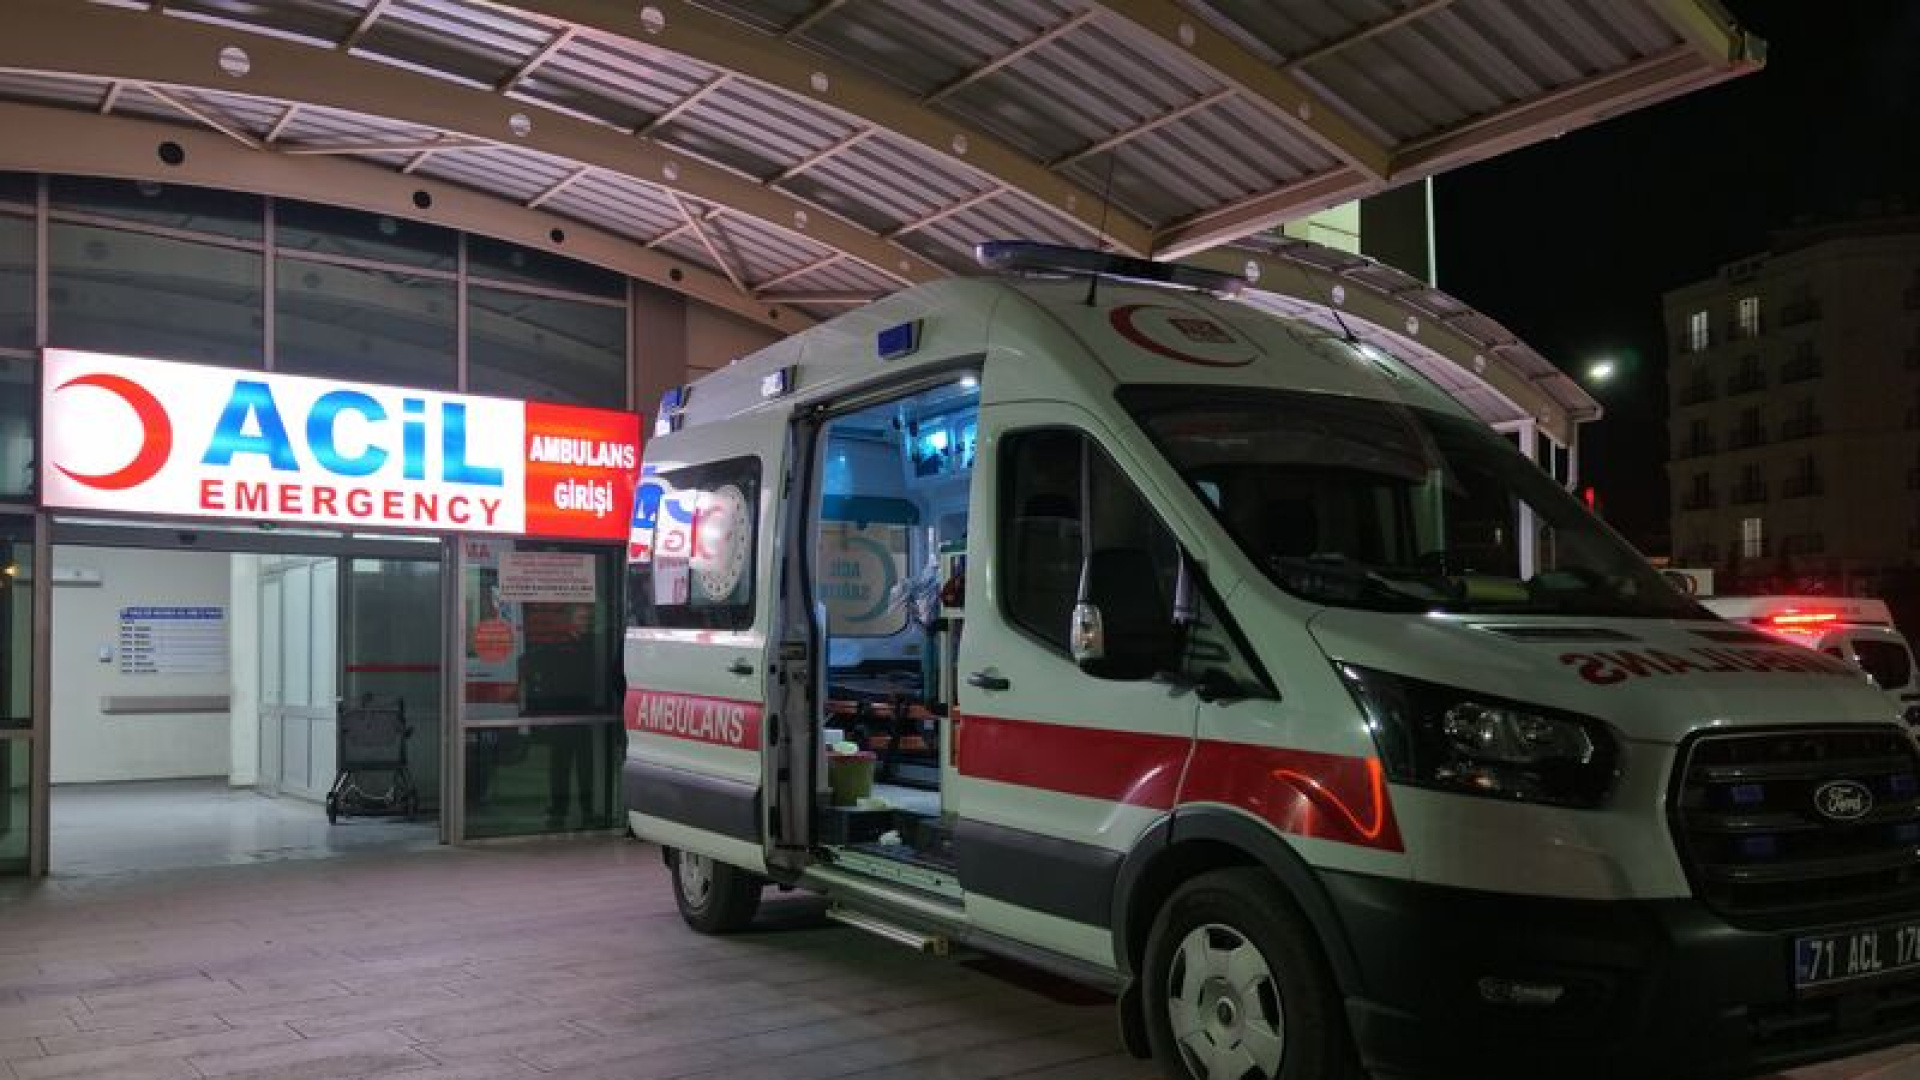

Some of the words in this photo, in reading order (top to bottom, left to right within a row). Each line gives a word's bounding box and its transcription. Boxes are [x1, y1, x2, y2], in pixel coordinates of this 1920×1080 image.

[530, 434, 635, 469] AMBULANS
[200, 480, 504, 525] EMERGENCY
[636, 693, 745, 744] AMBULANS
[1828, 786, 1861, 811] Ford
[1809, 940, 1834, 979] 71
[1848, 932, 1882, 973] ACL
